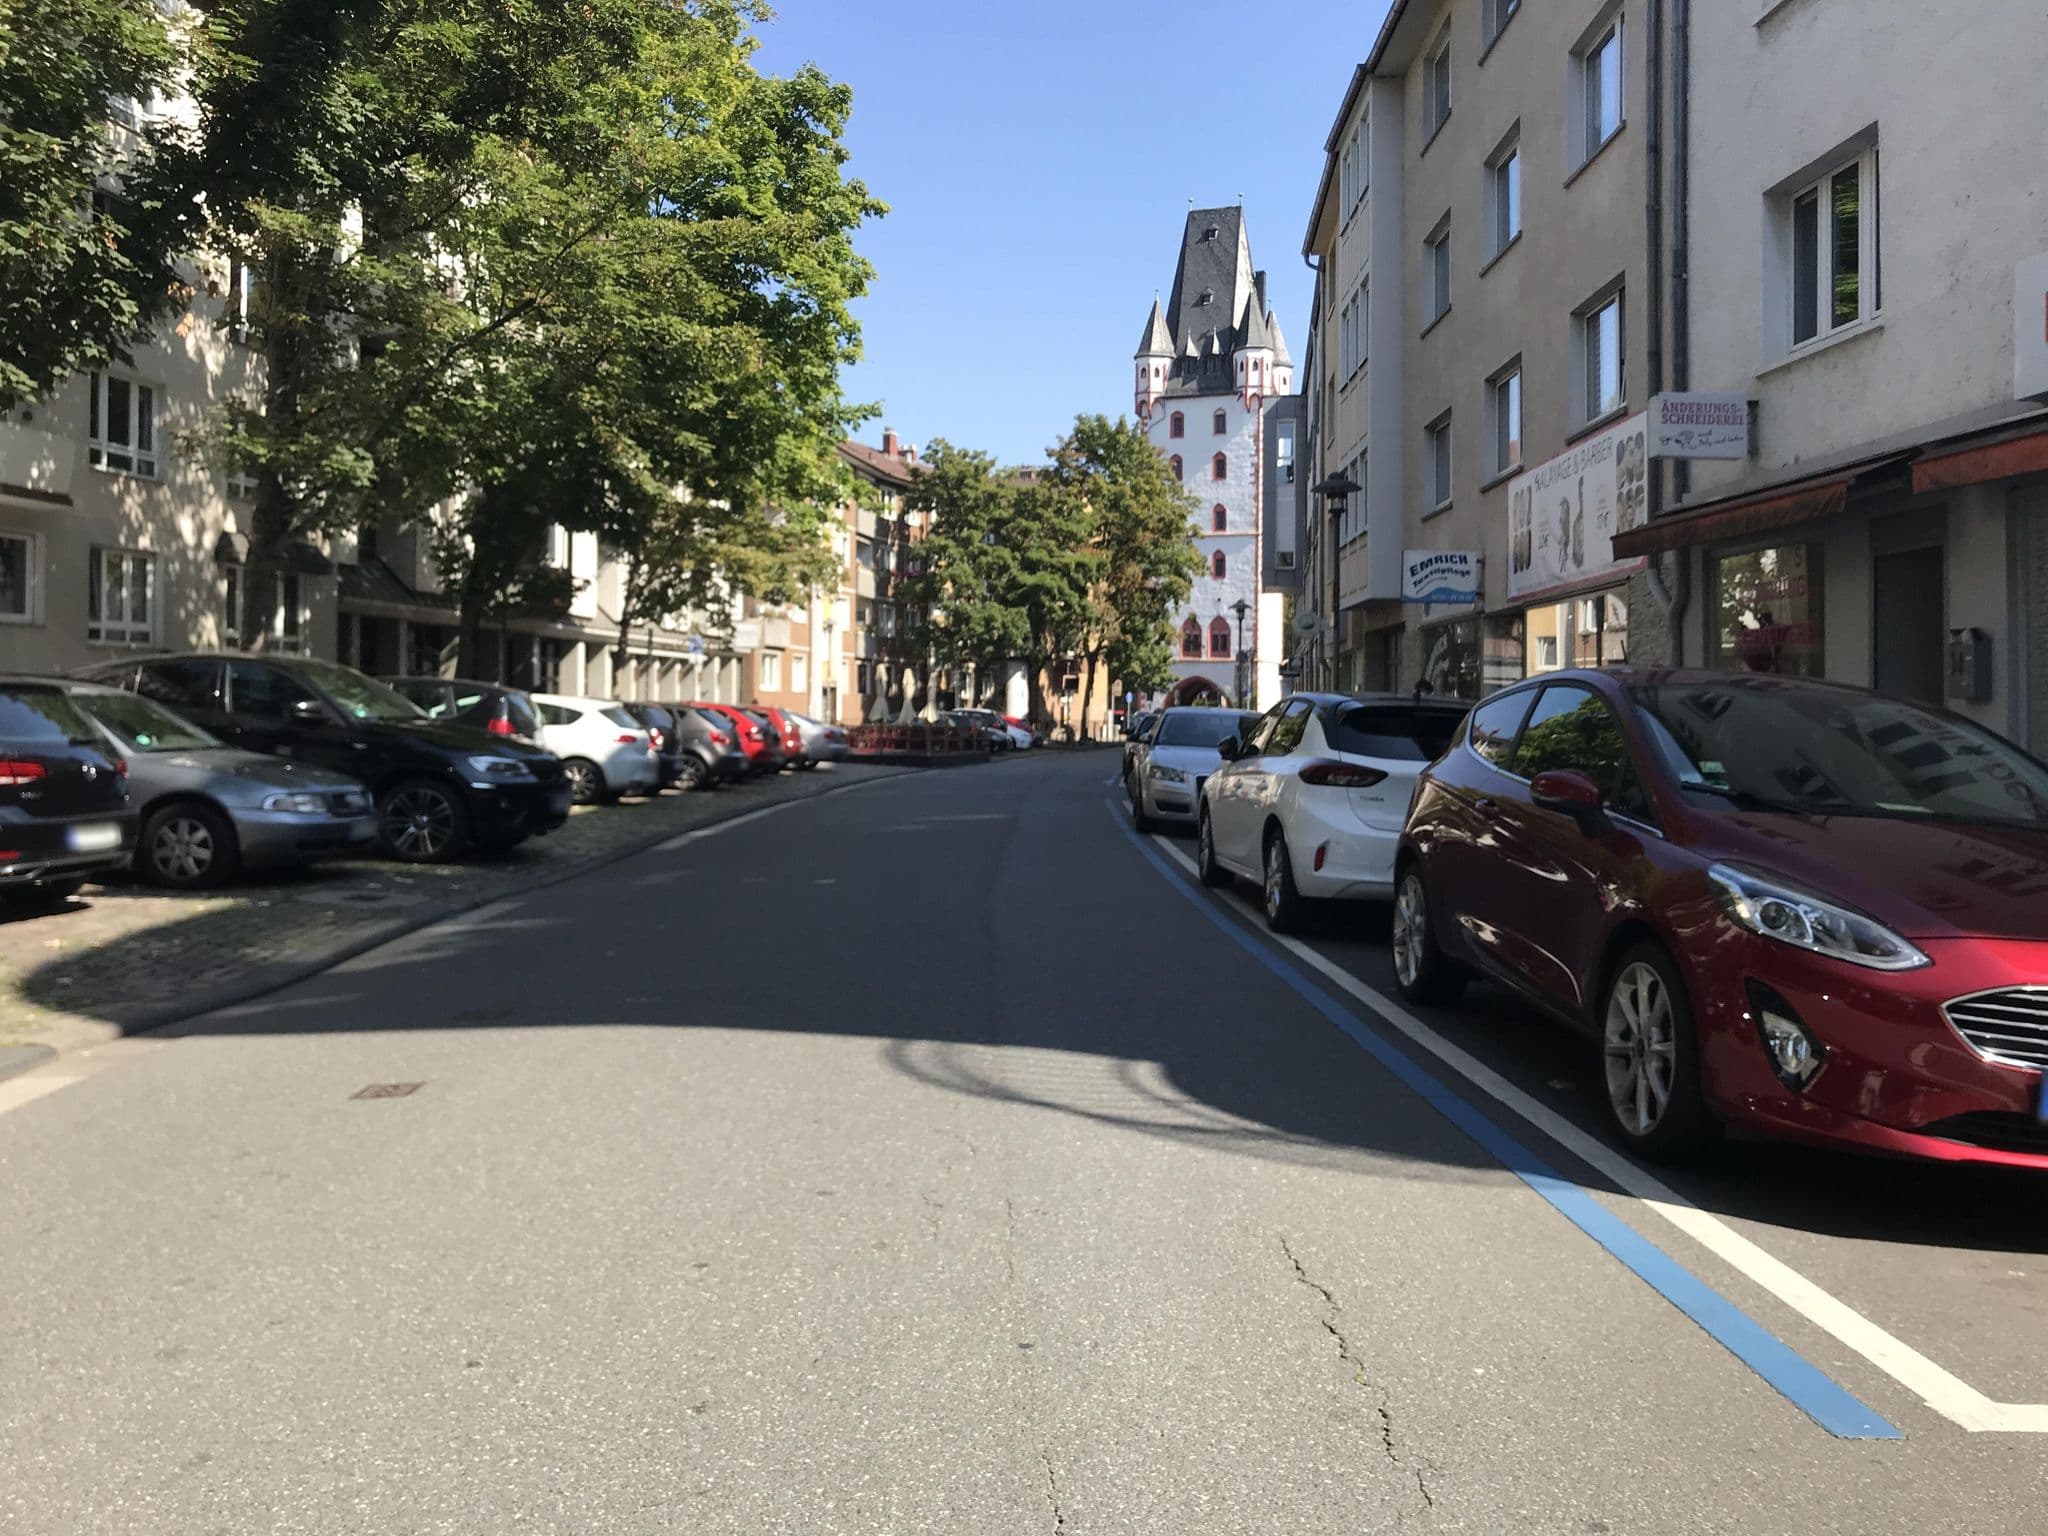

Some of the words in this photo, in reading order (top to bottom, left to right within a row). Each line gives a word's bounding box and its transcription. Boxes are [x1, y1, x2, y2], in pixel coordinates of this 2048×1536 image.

[1661, 413, 1744, 425] SCHNEIDEREI
[1581, 436, 1613, 471] BARBER
[1409, 554, 1468, 577] EMRICH
